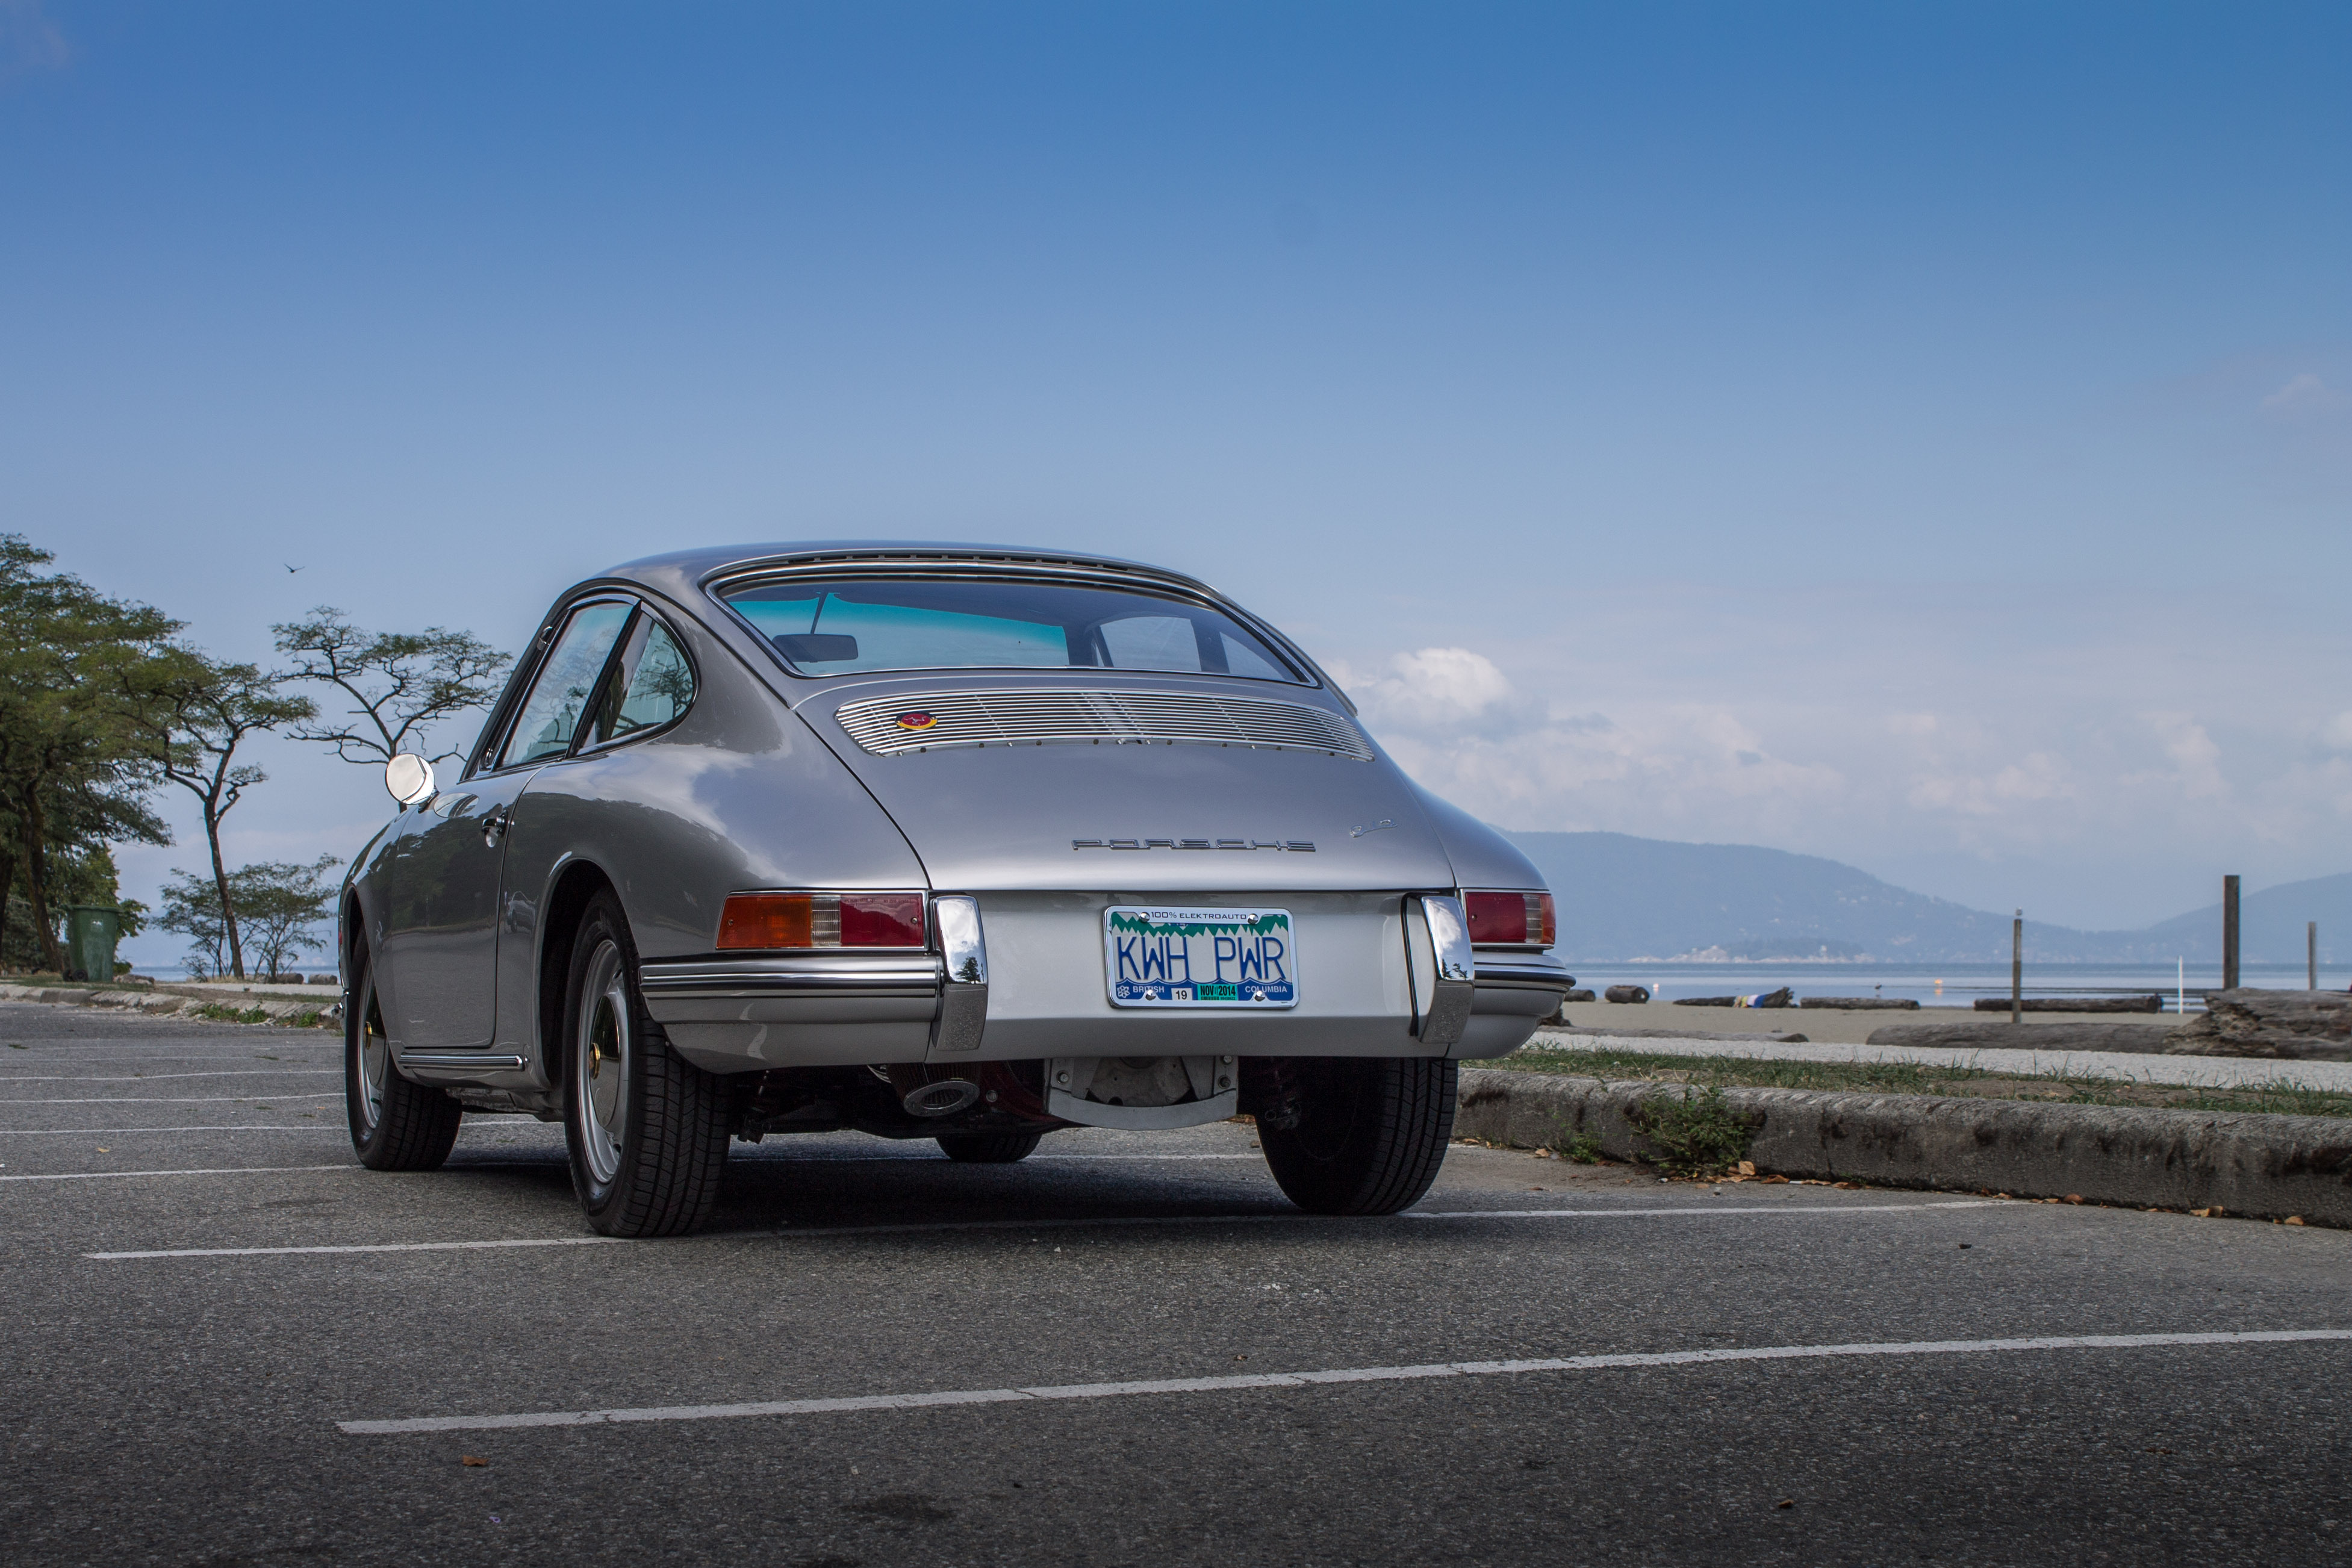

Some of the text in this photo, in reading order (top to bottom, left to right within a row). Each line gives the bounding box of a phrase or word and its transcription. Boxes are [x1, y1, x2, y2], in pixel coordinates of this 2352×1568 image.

[1071, 839, 1316, 852] PORSCHE
[1117, 936, 1286, 980] KWH PWR
[1175, 990, 1187, 1000] 19
[1200, 985, 1236, 996] NOV 2014
